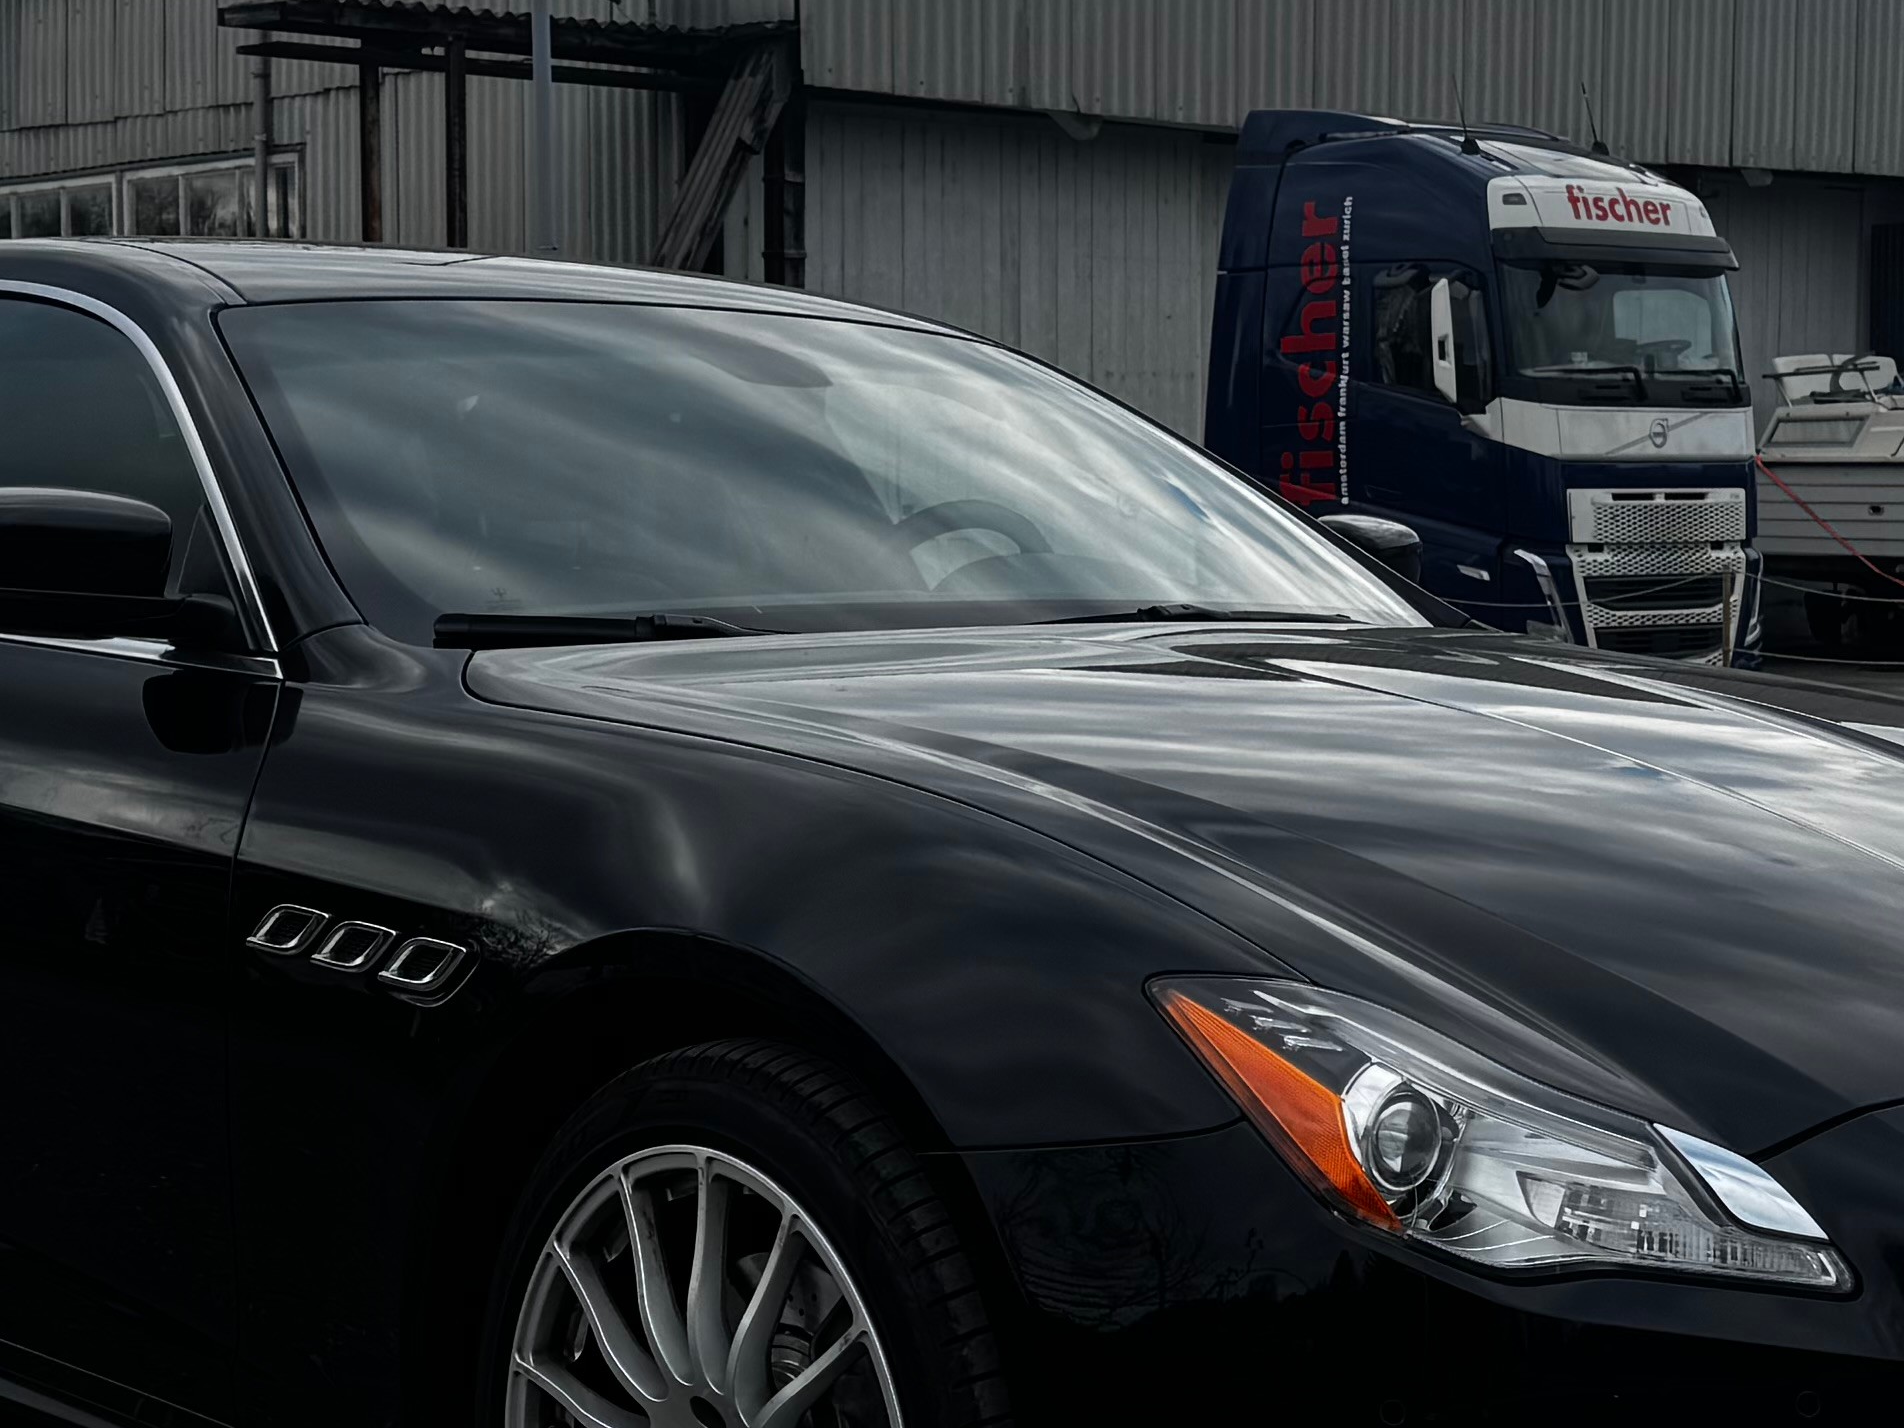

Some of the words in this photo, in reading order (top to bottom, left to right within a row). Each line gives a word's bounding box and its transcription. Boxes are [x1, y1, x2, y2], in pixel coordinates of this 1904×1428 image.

[1342, 196, 1353, 241] zurich
[1566, 183, 1672, 227] fischer
[1341, 289, 1351, 349] warsaw
[1278, 200, 1340, 508] fischer
